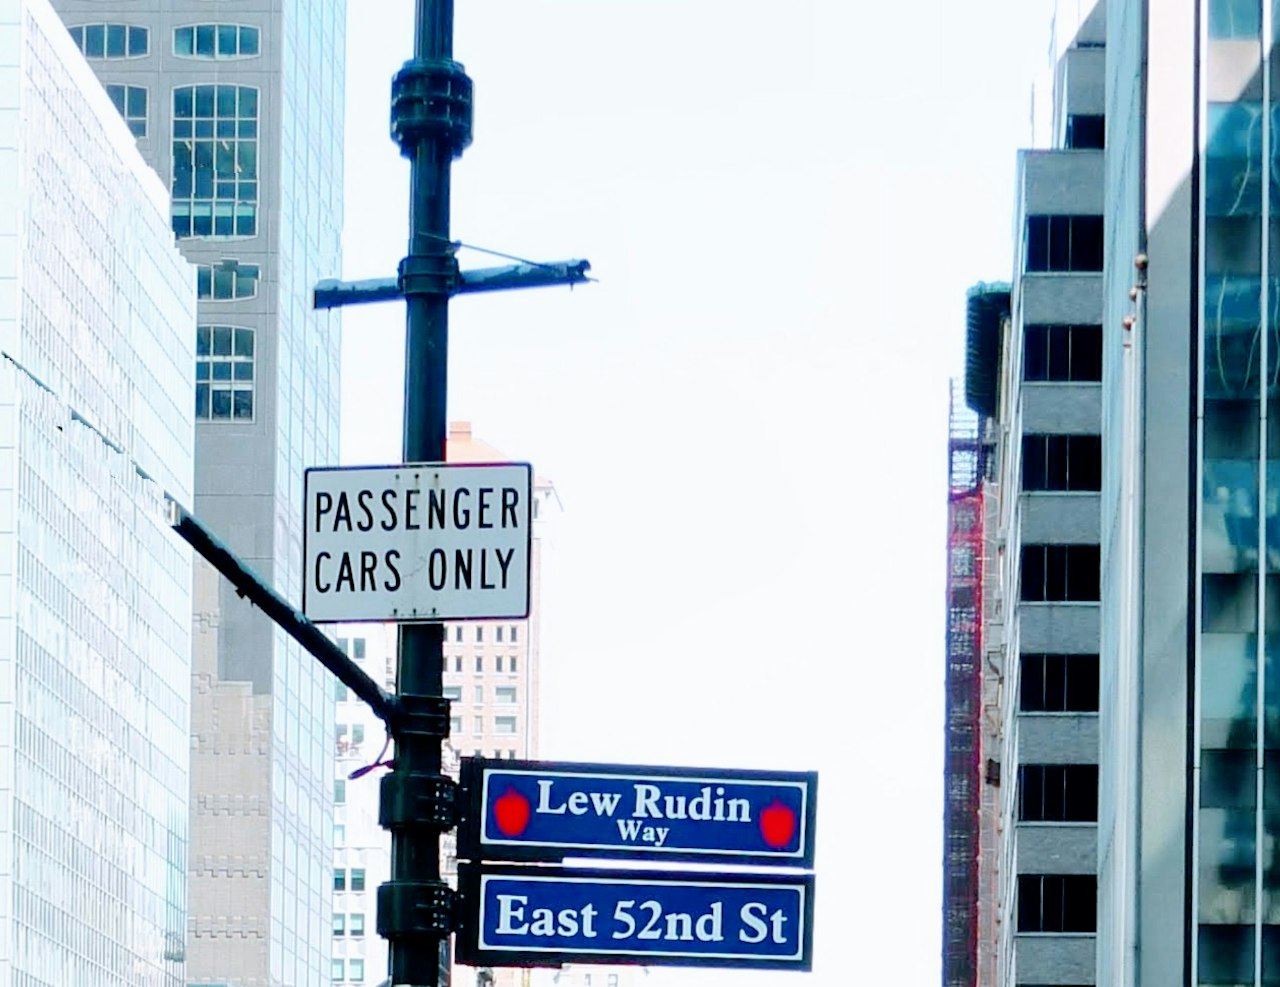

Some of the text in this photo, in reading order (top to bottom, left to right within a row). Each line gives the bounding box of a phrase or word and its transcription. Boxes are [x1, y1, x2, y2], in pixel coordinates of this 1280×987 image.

[315, 487, 519, 532] PASSENGER
[315, 548, 515, 593] CARS ONLY
[536, 780, 751, 823] Lew Rudin
[617, 819, 670, 847] Way
[494, 894, 788, 944] East 52nd St
